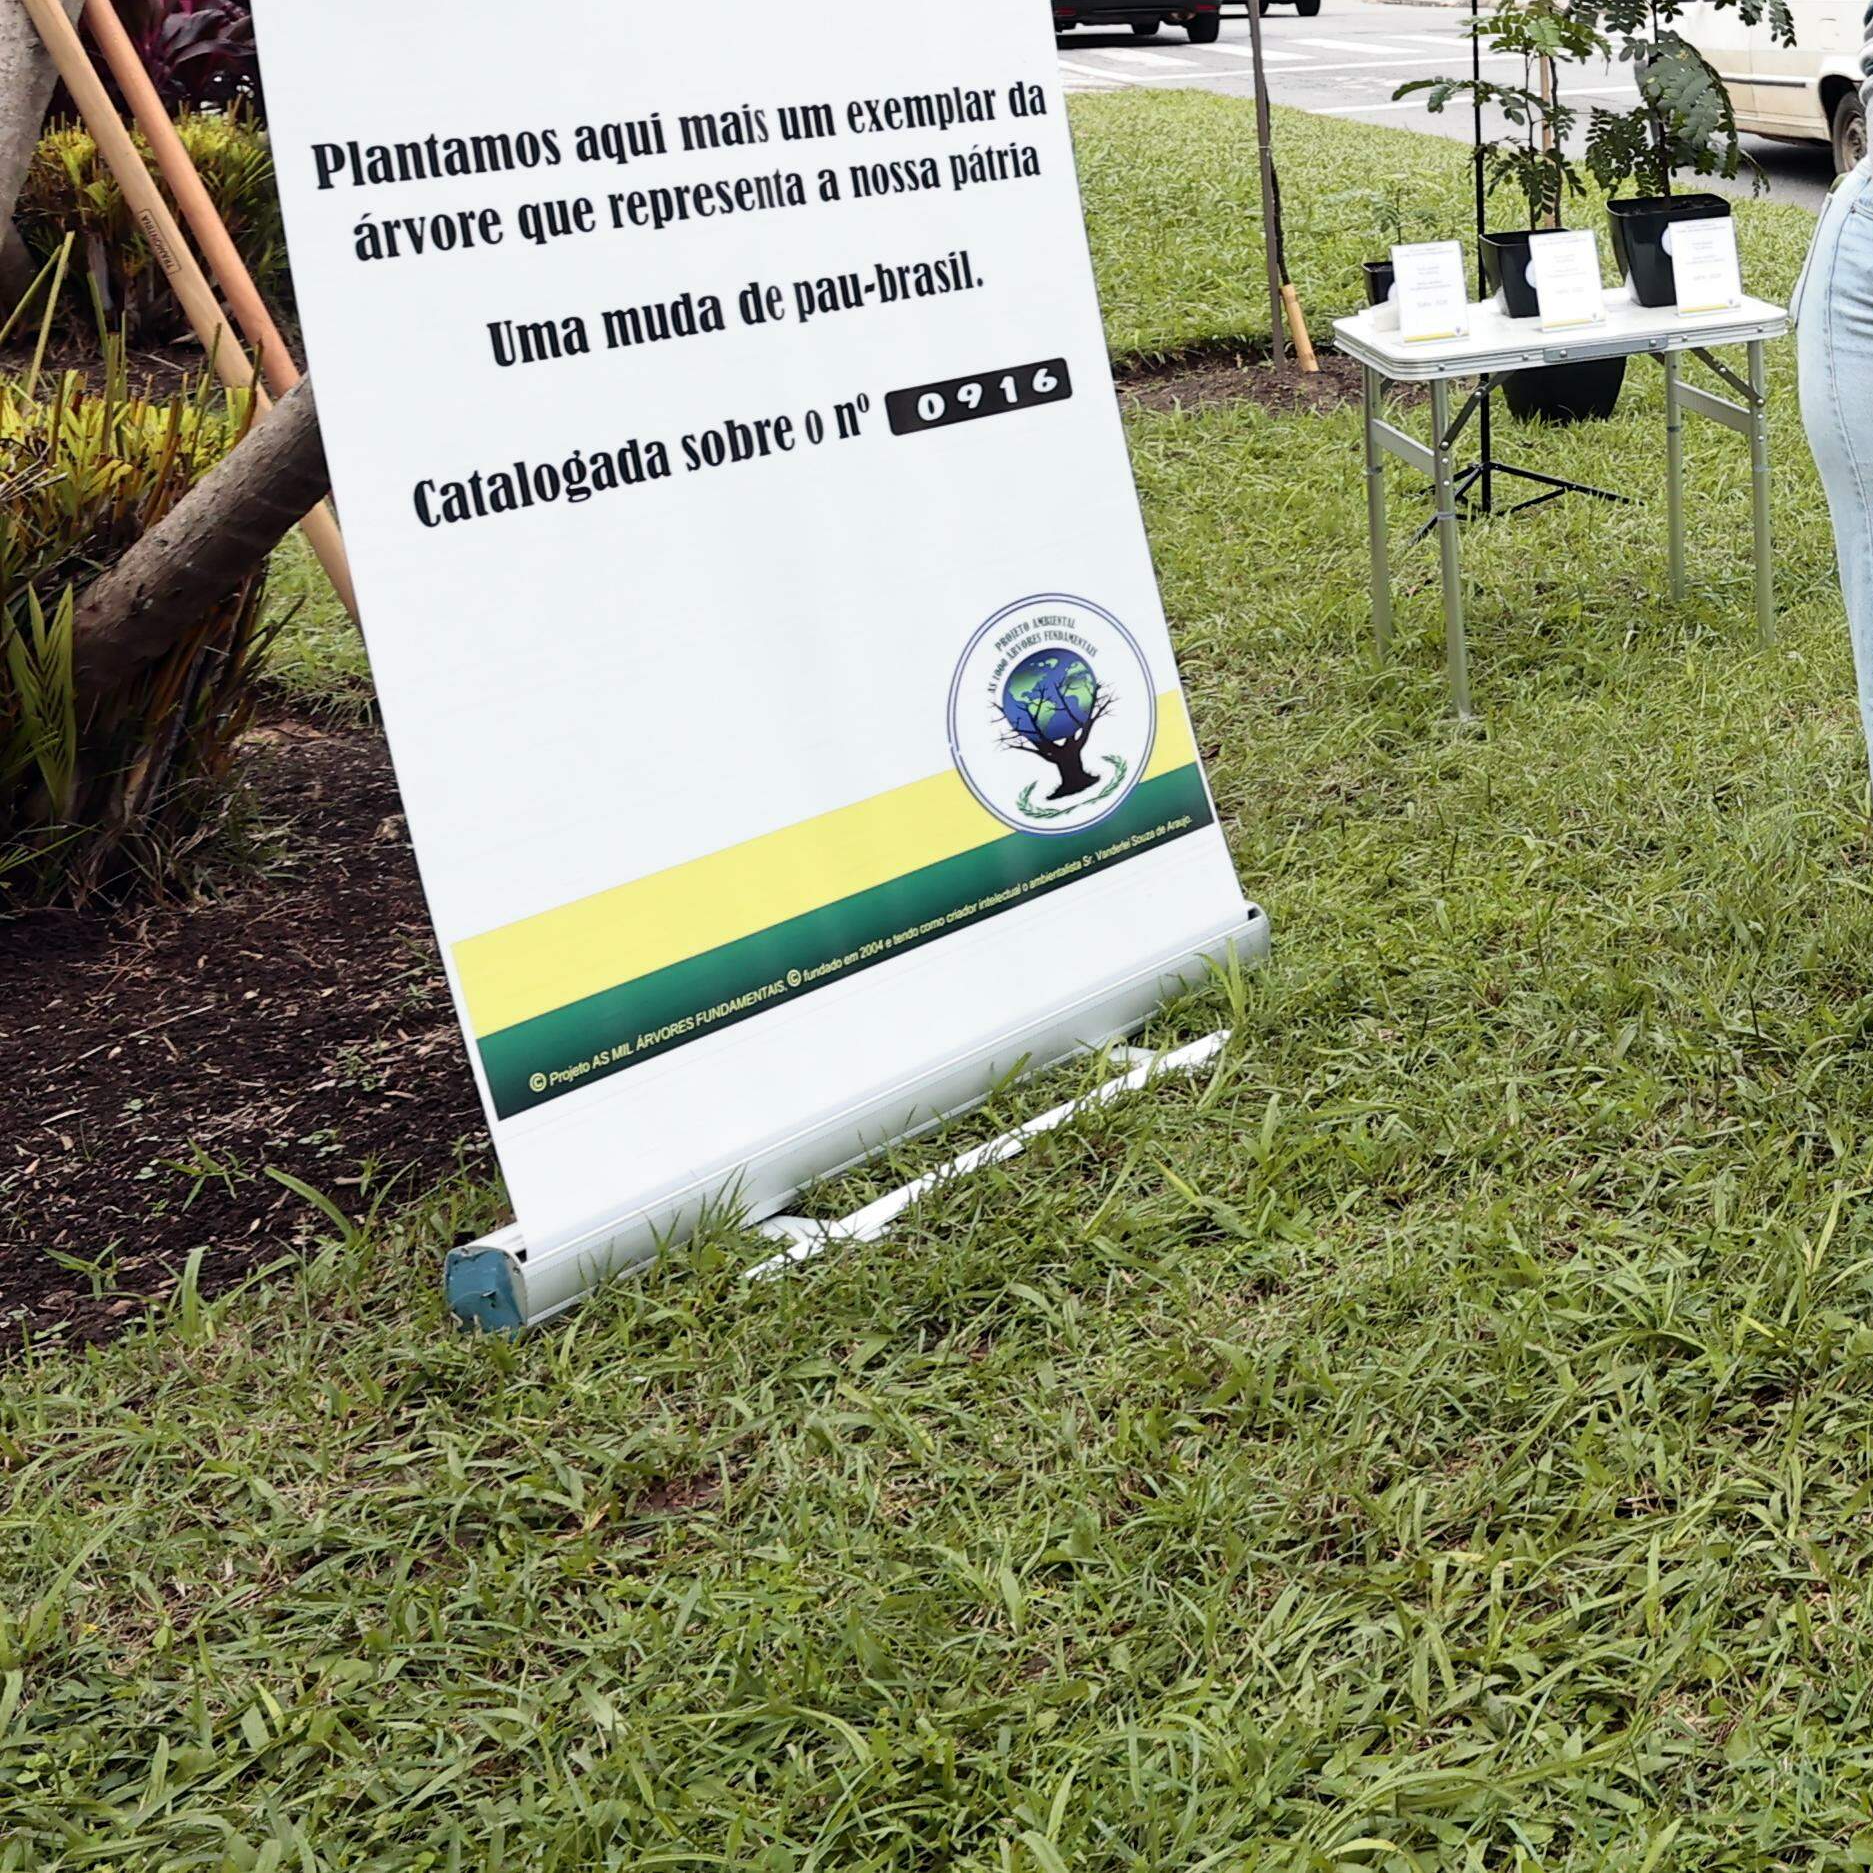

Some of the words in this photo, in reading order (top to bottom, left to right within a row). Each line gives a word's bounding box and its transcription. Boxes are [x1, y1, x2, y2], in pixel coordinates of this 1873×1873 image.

[311, 130, 560, 189] Plantamos
[575, 113, 667, 164] aqui
[679, 104, 768, 150] mais
[778, 104, 836, 140] um
[847, 87, 995, 133] exemplar
[1009, 82, 1046, 117] da
[354, 209, 503, 261] árvore
[518, 198, 595, 245] que
[608, 170, 806, 229] representa
[818, 169, 840, 202] a
[850, 158, 940, 198] nossa
[950, 143, 1040, 190] pátria
[487, 317, 590, 366] Uma
[602, 293, 725, 348] muda
[739, 282, 784, 325] de
[794, 251, 983, 322] pau-brasil.
[414, 439, 671, 527] Catalogada
[682, 416, 794, 471] sobre
[806, 410, 823, 444] o
[834, 393, 869, 439] nº
[917, 368, 1058, 421] 0916
[1032, 616, 1076, 629] AMBIENTAL
[1044, 630, 1098, 658] FUNDAMENTAIS
[549, 1061, 590, 1087] Projeto
[592, 1051, 610, 1069] AS
[611, 1042, 634, 1061] MIL
[636, 1017, 694, 1051] ÁRVORES
[803, 958, 843, 982] fundado
[844, 951, 859, 965] em
[859, 941, 884, 959] 2004
[885, 938, 893, 948] e
[893, 927, 919, 946] tendo
[920, 917, 945, 934] como
[947, 903, 977, 923] criador
[978, 884, 1021, 910] intelectual
[1022, 883, 1028, 892] o
[1029, 860, 1082, 890] ambientalista
[1083, 855, 1095, 867] Sr.
[1131, 830, 1155, 847] Souza
[1155, 825, 1166, 837] de
